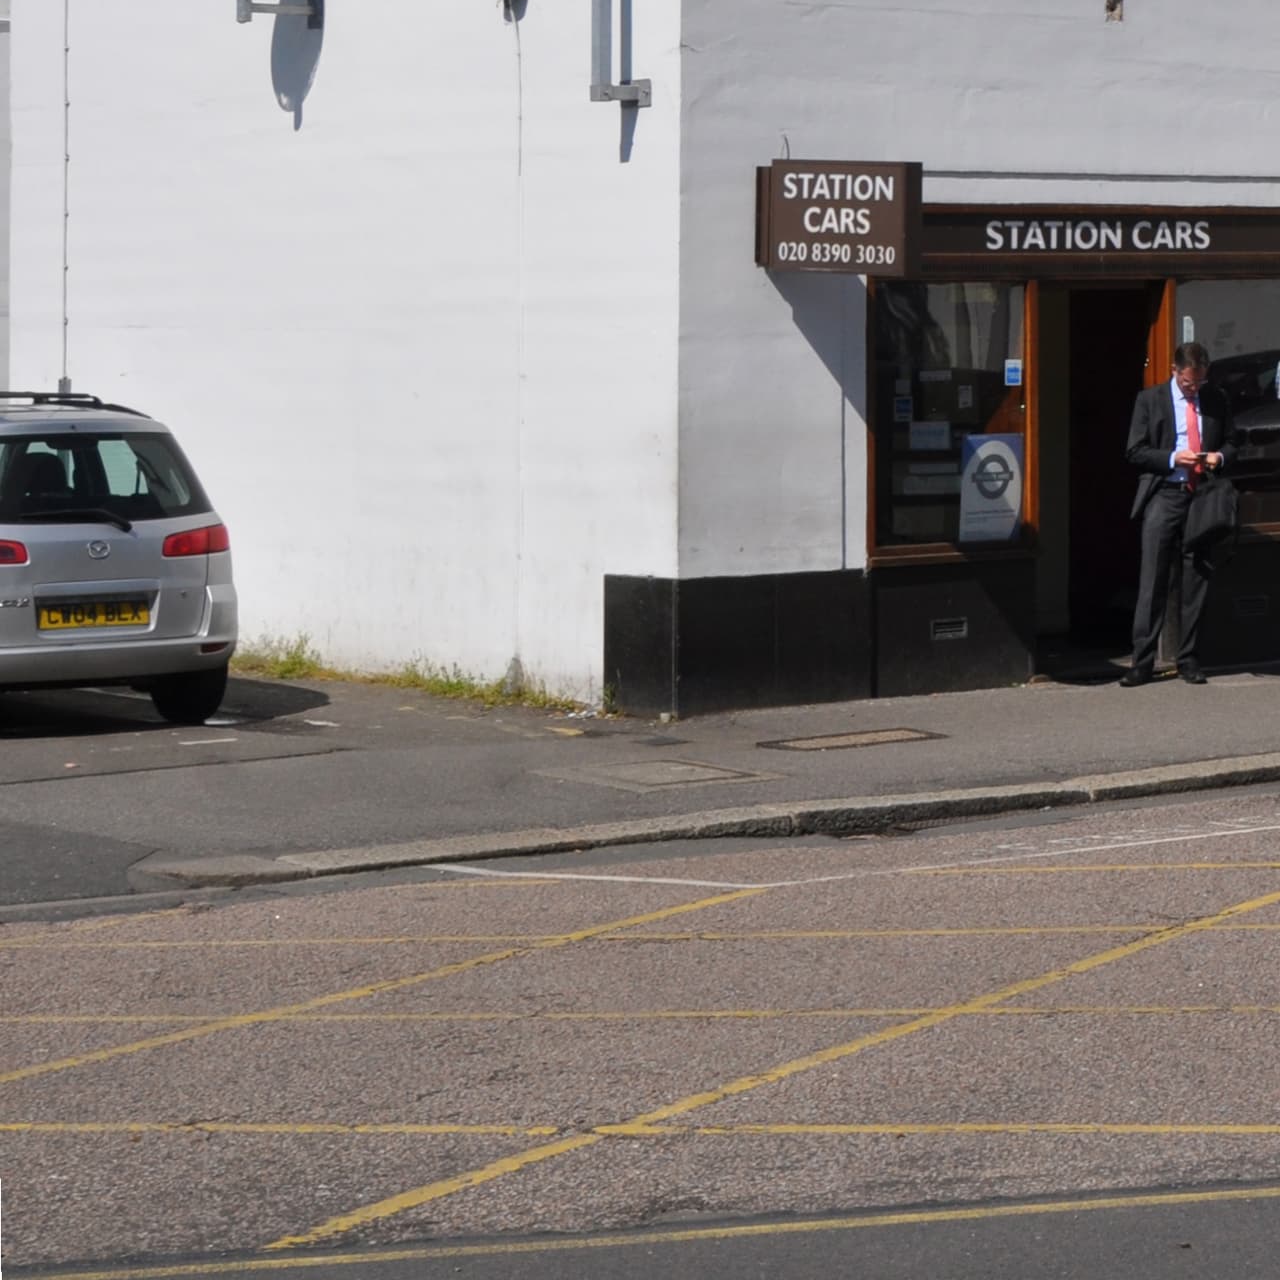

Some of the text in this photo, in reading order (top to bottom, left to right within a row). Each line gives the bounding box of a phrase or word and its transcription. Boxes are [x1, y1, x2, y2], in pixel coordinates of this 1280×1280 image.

[783, 172, 895, 202] STATION
[803, 205, 871, 235] CARS
[985, 220, 1211, 251] STATION CARS
[778, 241, 896, 265] 020 8390 3030
